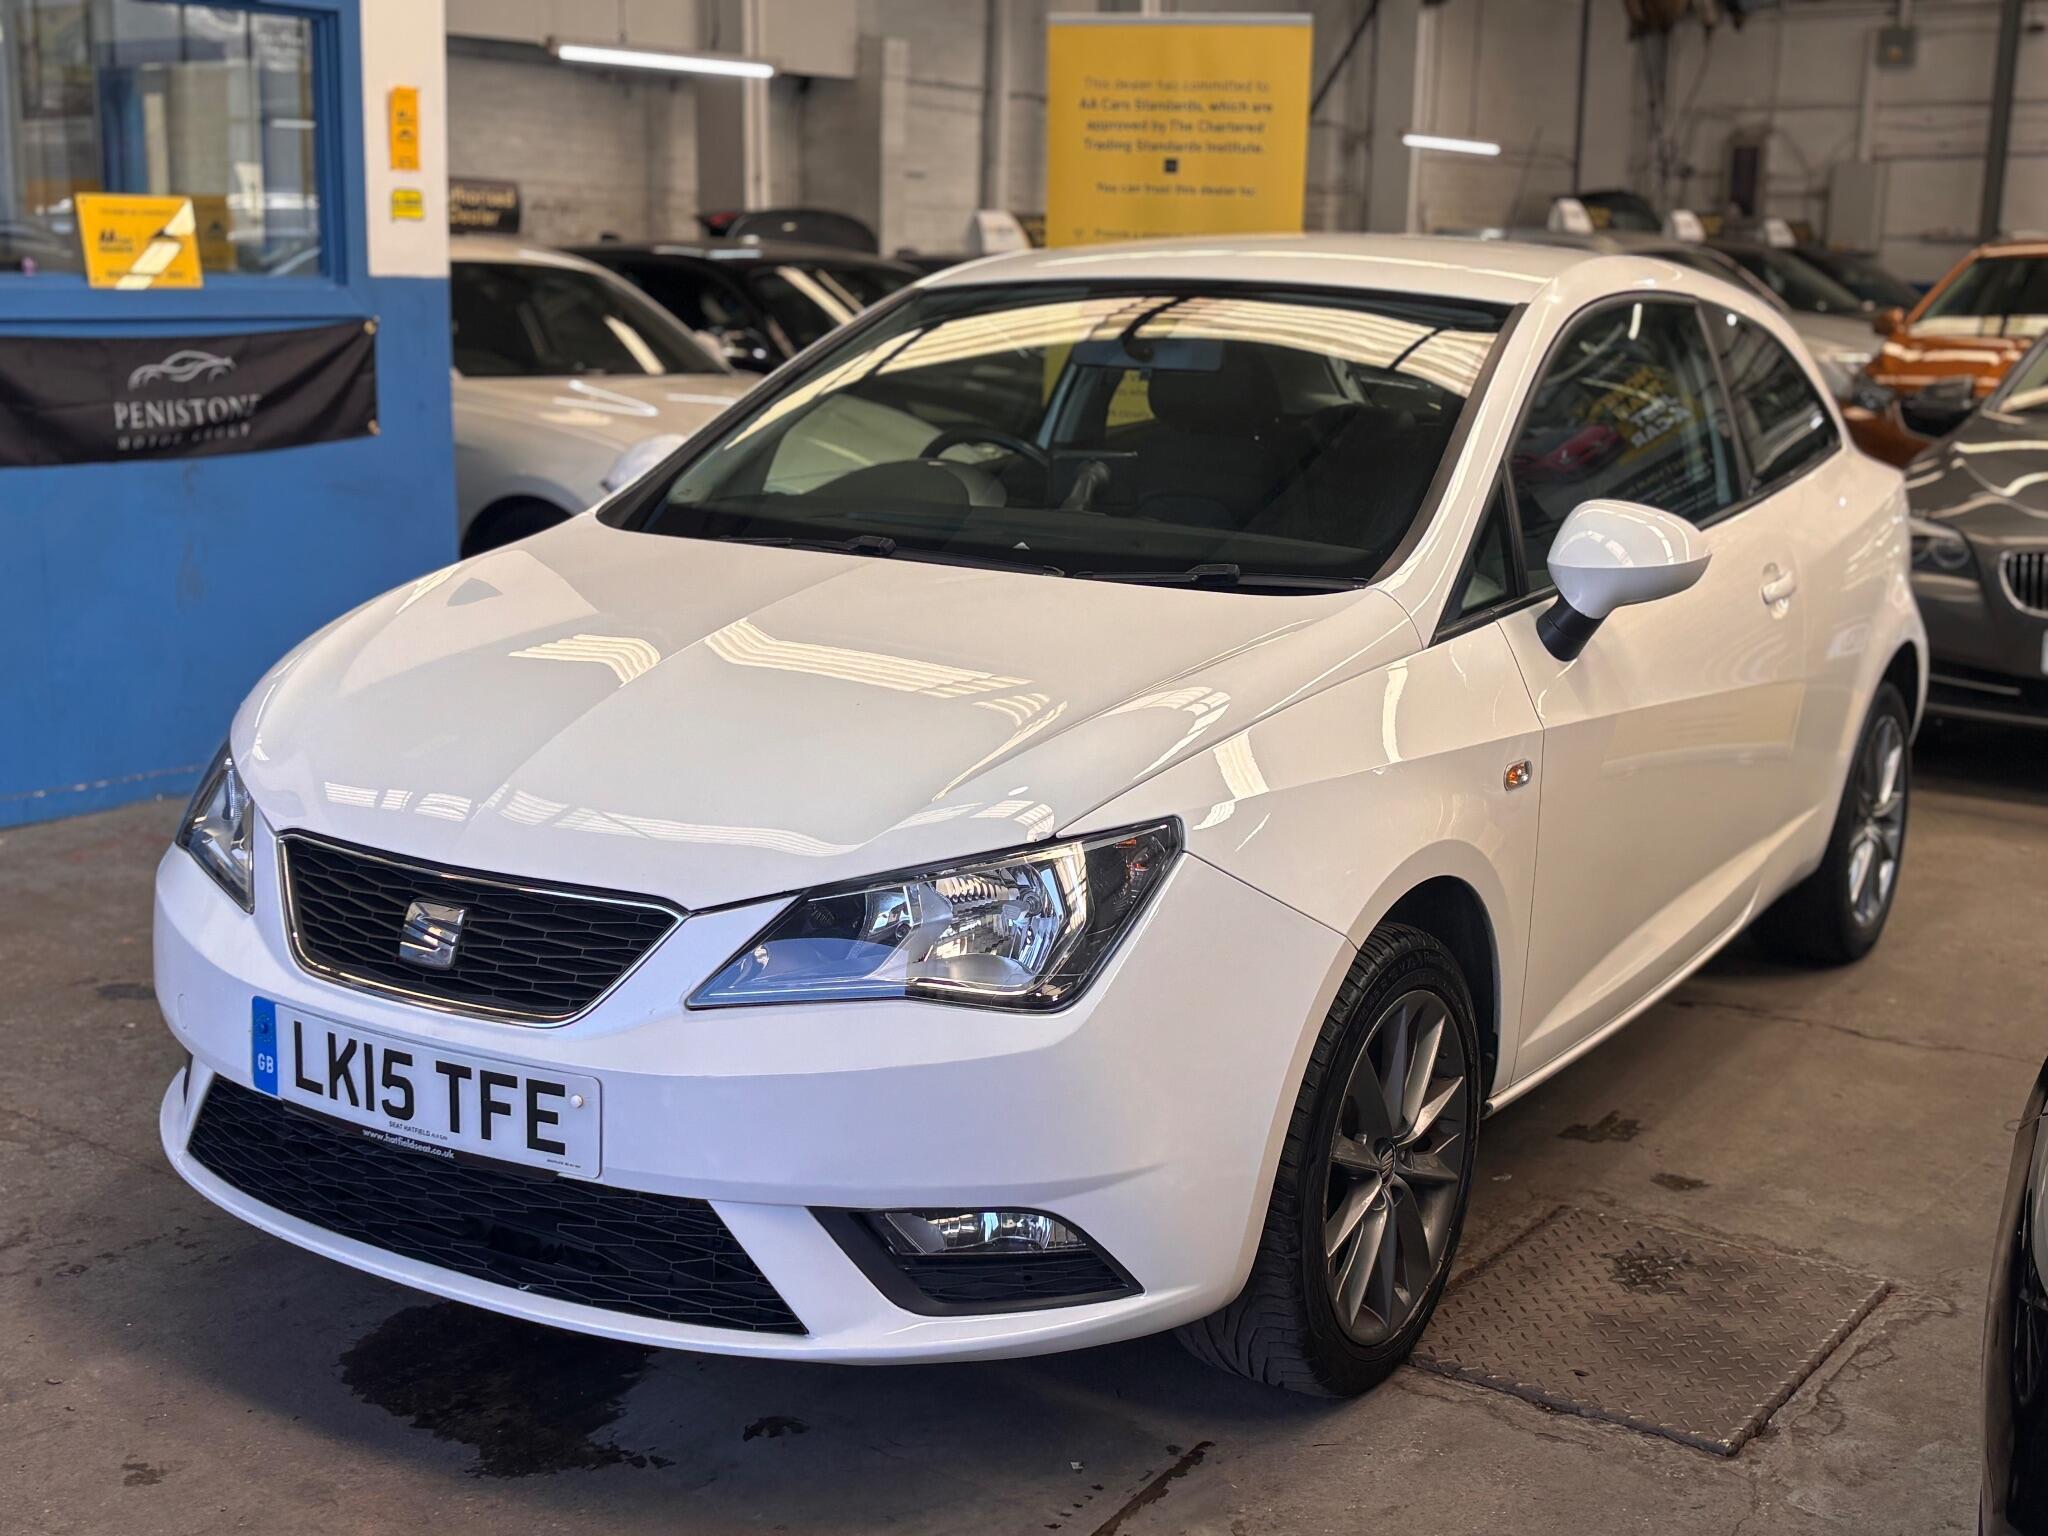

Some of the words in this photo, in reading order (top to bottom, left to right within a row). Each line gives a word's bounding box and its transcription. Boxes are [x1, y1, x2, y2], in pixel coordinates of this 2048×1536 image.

[1208, 100, 1247, 112] which
[1087, 120, 1146, 133] approved
[1169, 119, 1192, 131] The
[1198, 120, 1265, 133] Chartered
[1084, 138, 1132, 154] Trading
[1136, 139, 1202, 152] Standards
[257, 1053, 274, 1073] GB
[293, 1020, 415, 1122] LK15
[436, 1060, 566, 1156] TFE
